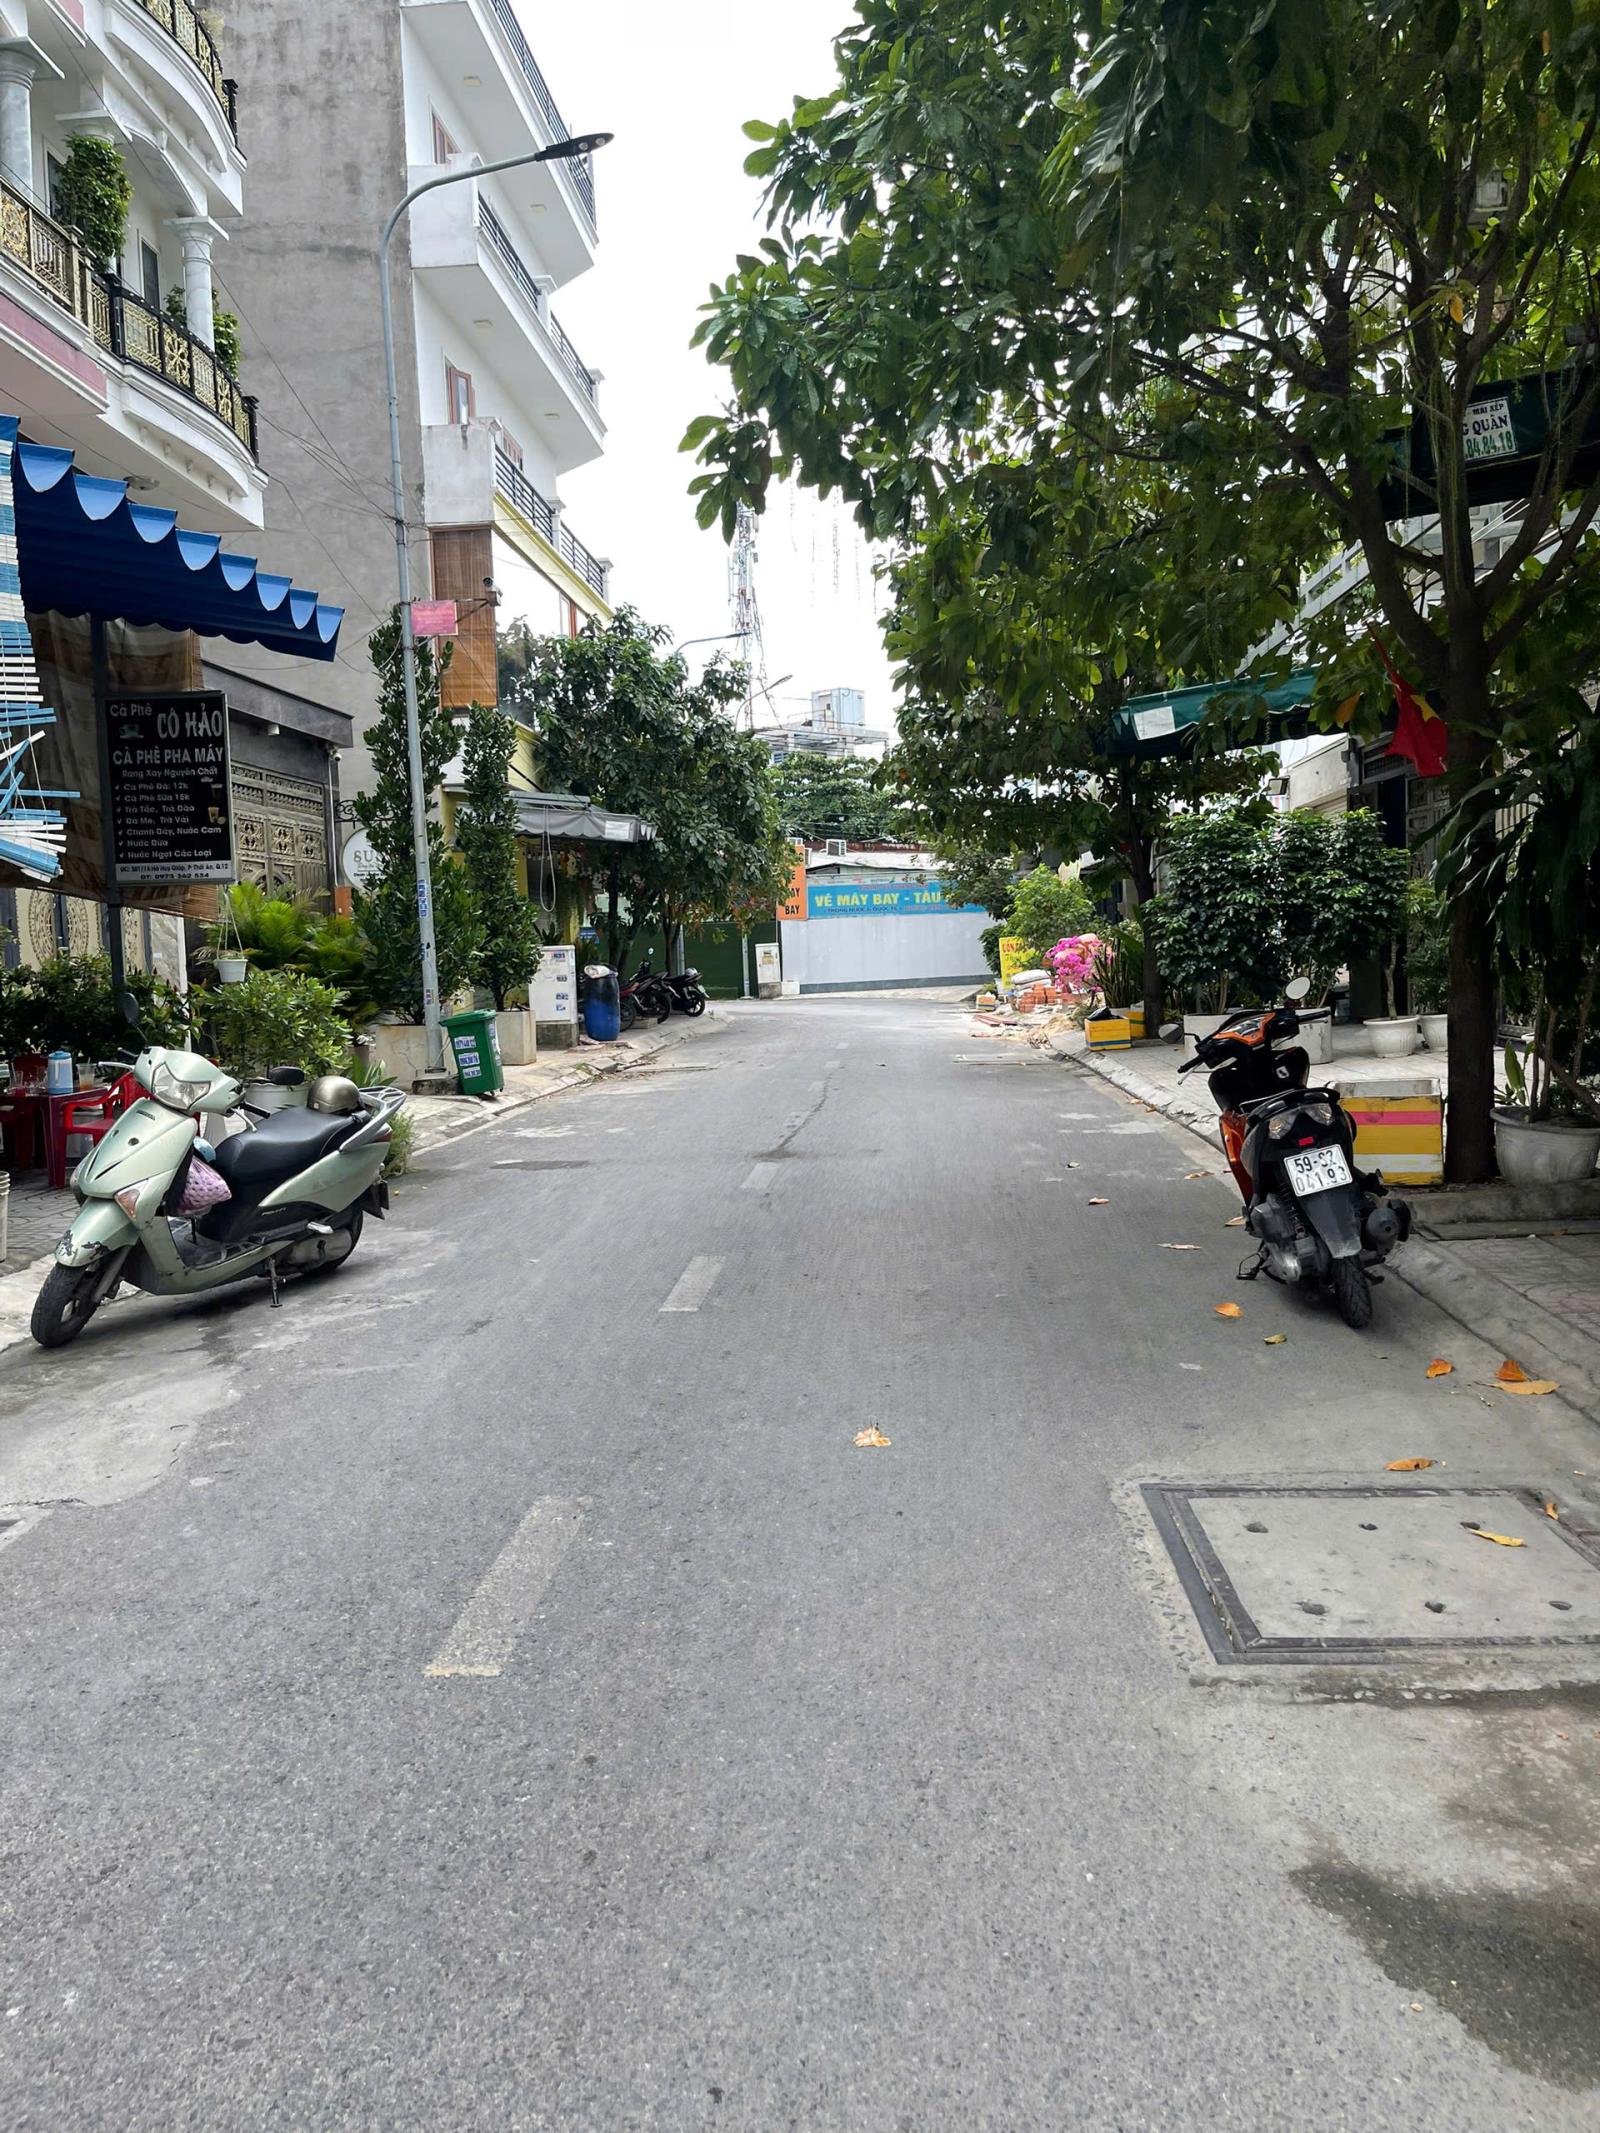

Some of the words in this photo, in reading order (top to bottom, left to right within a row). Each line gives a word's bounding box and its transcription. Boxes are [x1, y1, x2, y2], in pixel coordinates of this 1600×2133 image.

[109, 702, 127, 717] Cà
[130, 702, 152, 716] Phê
[157, 707, 180, 739] CÔ
[185, 703, 223, 737] HẢO
[113, 746, 133, 765] CÀ
[136, 746, 161, 764] PHÊ
[164, 748, 191, 764] PHA
[194, 744, 223, 762] MÁY
[201, 826, 222, 834] Cam
[872, 892, 900, 905] BAY
[785, 905, 800, 915] BAY
